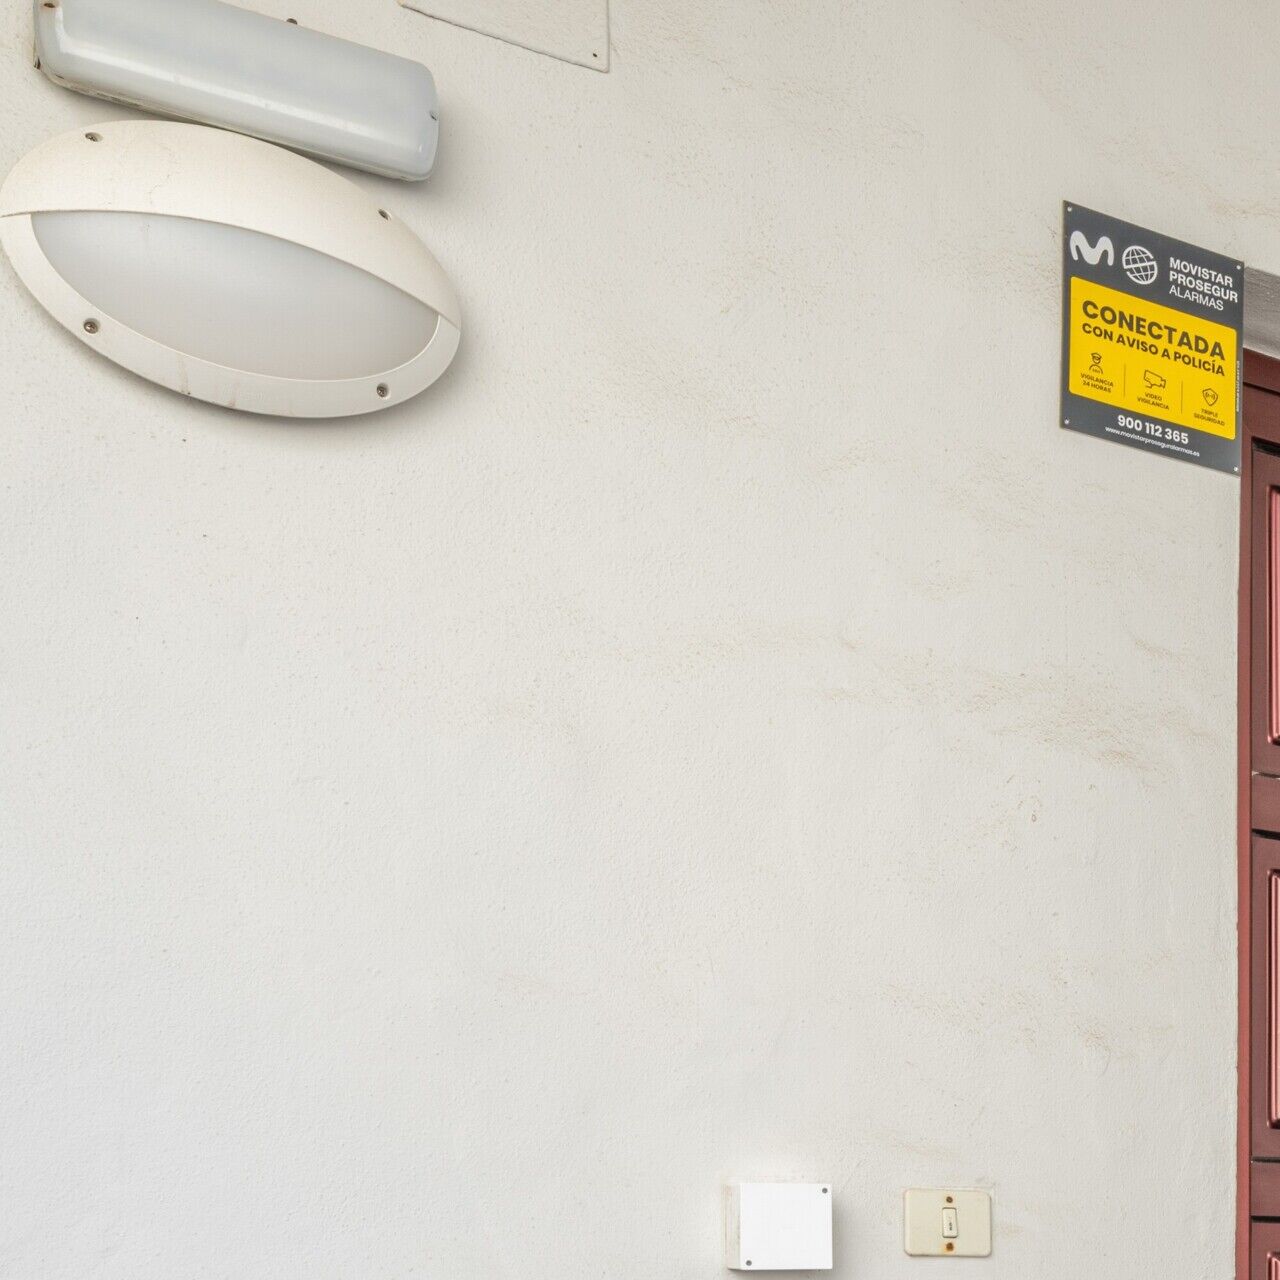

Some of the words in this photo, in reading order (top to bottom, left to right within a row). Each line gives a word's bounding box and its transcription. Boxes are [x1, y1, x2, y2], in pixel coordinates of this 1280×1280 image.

[1169, 256, 1233, 288] MOVISTAR
[1169, 270, 1238, 303] PROSEGUR
[1169, 284, 1224, 311] ALARMAS
[1082, 300, 1226, 361] CONECTADA
[1081, 323, 1113, 342] CON
[1116, 334, 1158, 356] AVISO
[1161, 348, 1171, 360] A
[1173, 351, 1225, 377] POLICÍA
[1080, 372, 1114, 387] VIGILANCIA
[1091, 383, 1111, 393] HORAS
[1144, 391, 1162, 402] VIDEO
[1117, 414, 1143, 431] 900
[1145, 422, 1162, 438] 112
[1164, 428, 1189, 445] 365
